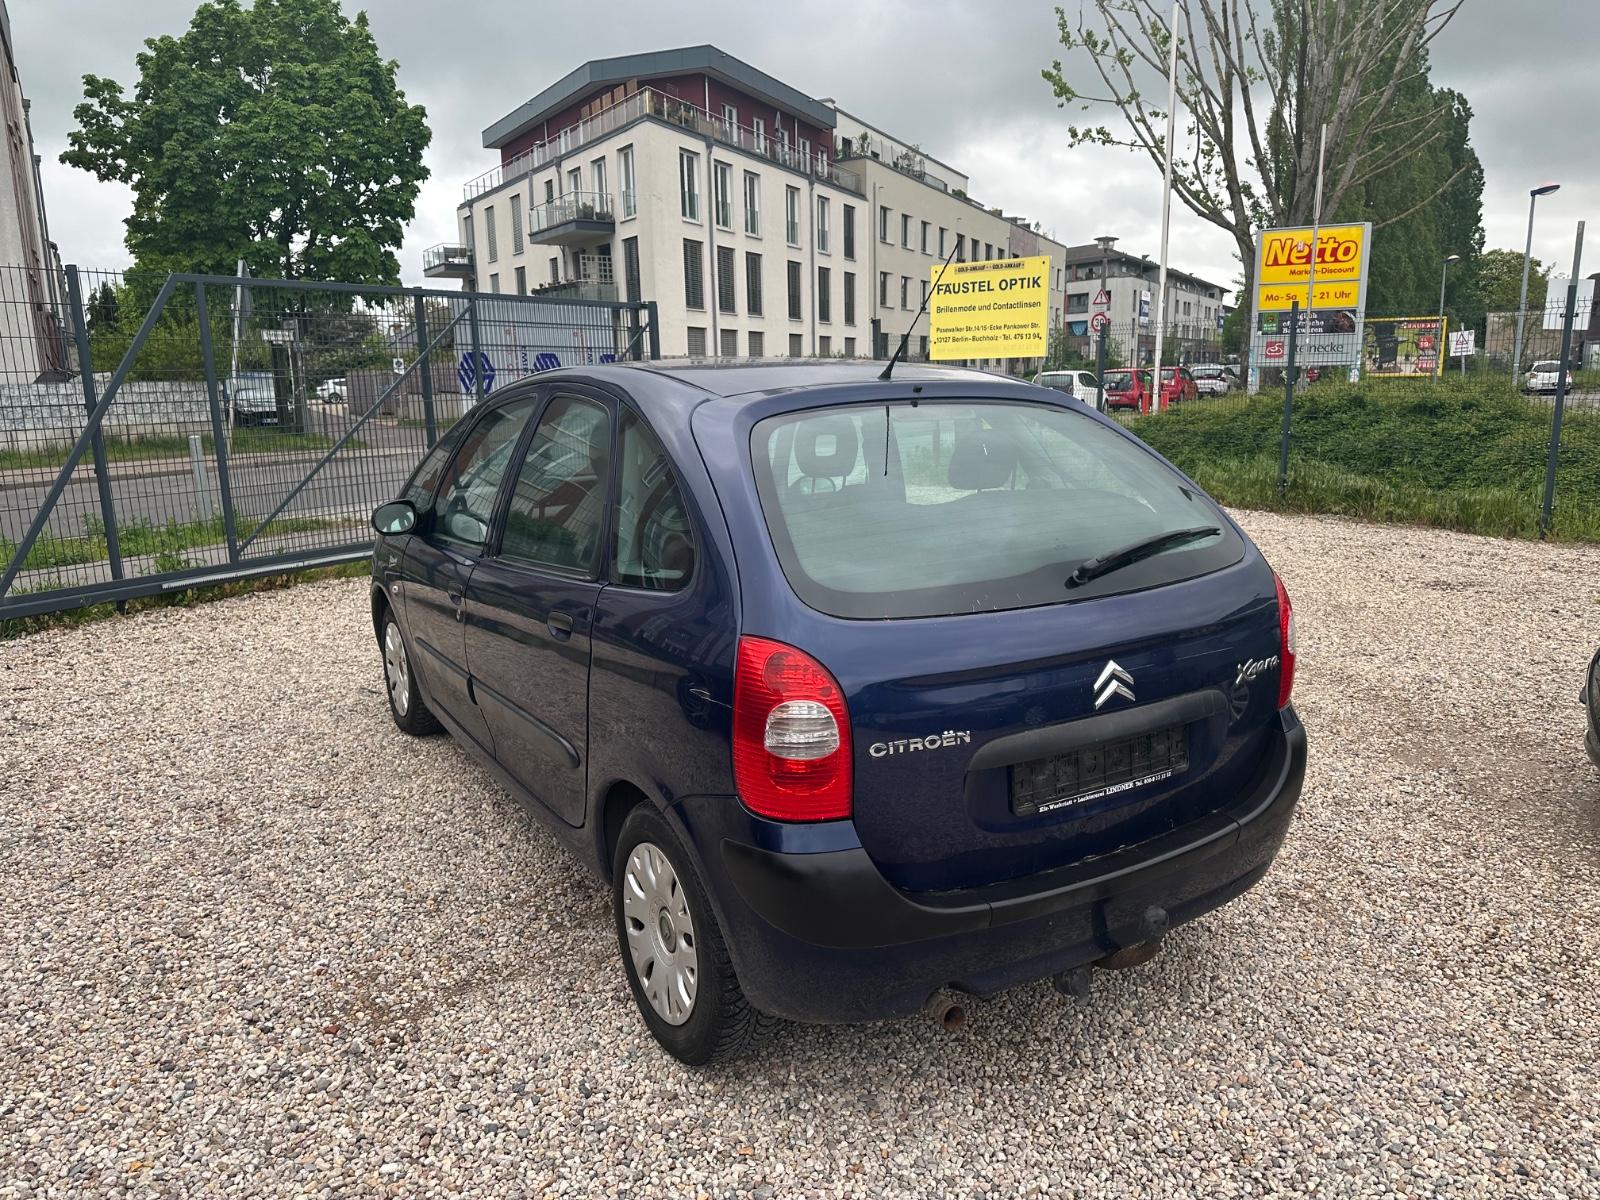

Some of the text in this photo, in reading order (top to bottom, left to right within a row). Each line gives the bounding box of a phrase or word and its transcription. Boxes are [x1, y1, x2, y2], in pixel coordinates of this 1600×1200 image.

[1265, 237, 1358, 266] Netto
[1289, 267, 1354, 275] Markn-Discount
[937, 276, 1042, 295] FÄUSTEL OPTIK
[1320, 291, 1329, 300] 21
[1334, 291, 1351, 299] Uhr
[936, 301, 1041, 314] Brillenmode und Contactlinsen
[1106, 782, 1134, 795] LINDNER
